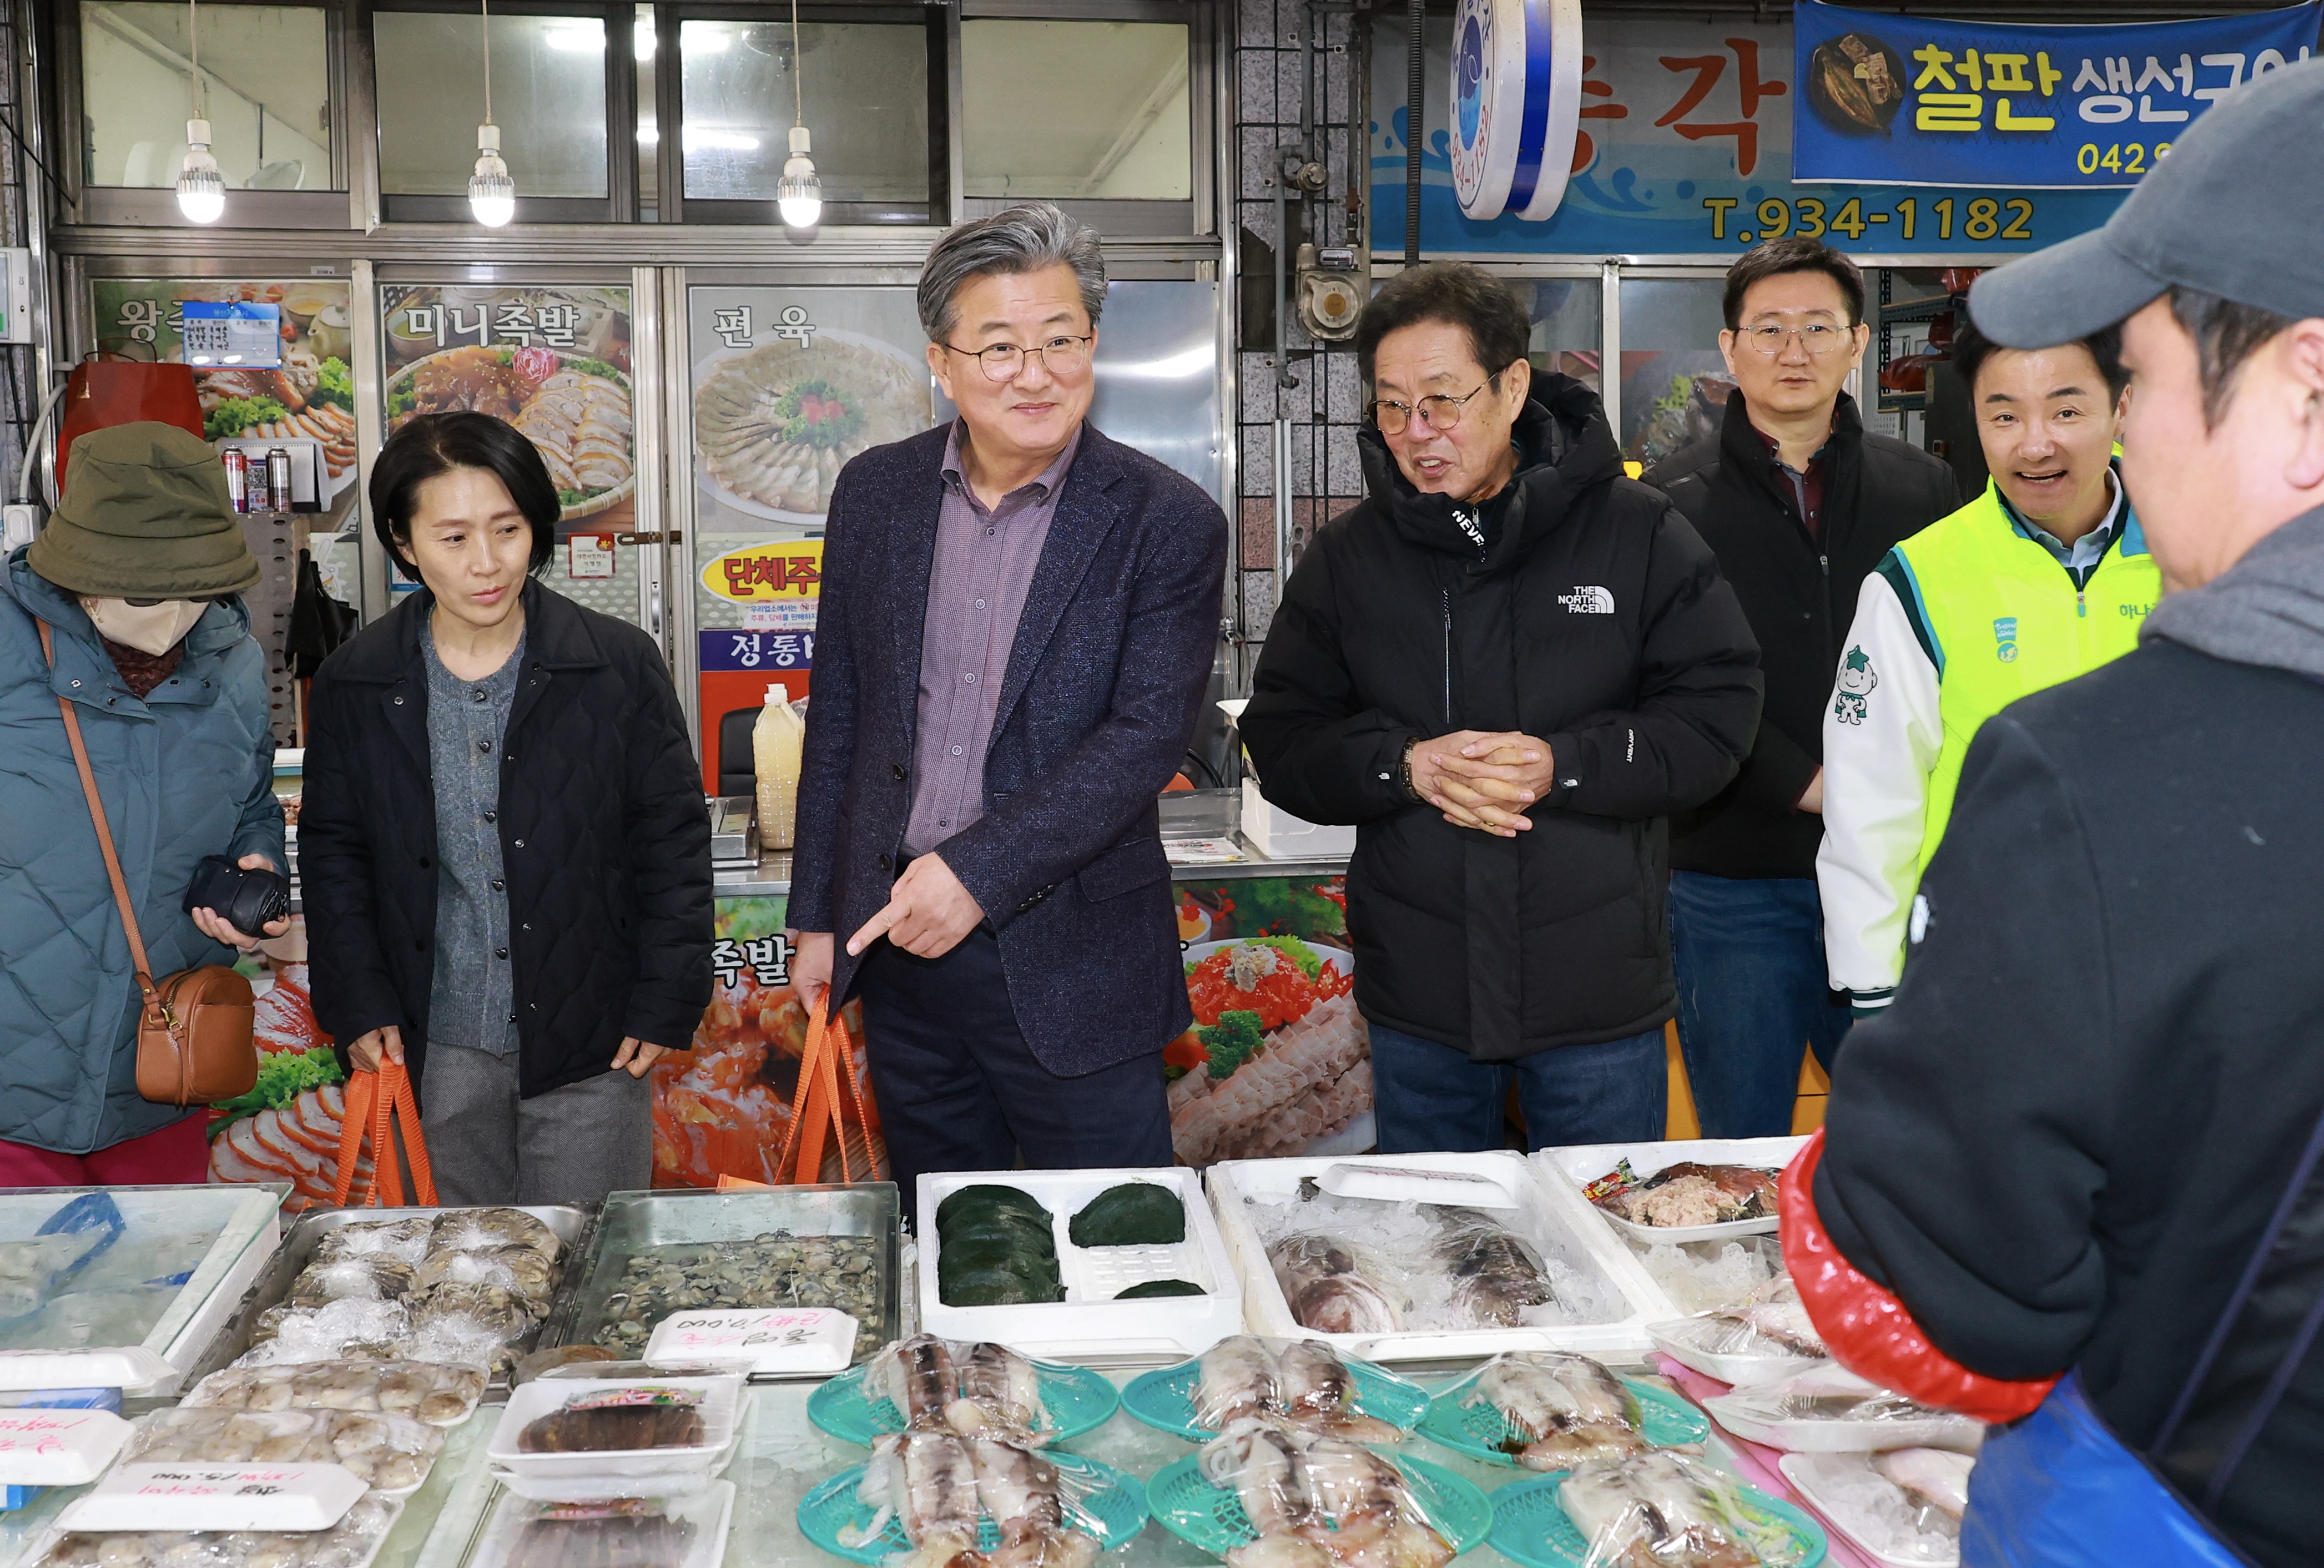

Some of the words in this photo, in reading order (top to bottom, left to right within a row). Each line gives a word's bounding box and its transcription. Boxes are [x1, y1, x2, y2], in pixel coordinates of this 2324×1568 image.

[1913, 44, 2063, 131] 철판
[1452, 104, 1489, 193] 934-1182
[1703, 198, 2034, 243] T.934-1182
[404, 304, 581, 348] 미니족발
[723, 556, 822, 596] 단체주
[1573, 586, 1595, 595] THE
[1557, 594, 1595, 604] NORTH
[1569, 603, 1595, 613] FACE
[1626, 728, 1634, 763] DRYVENT
